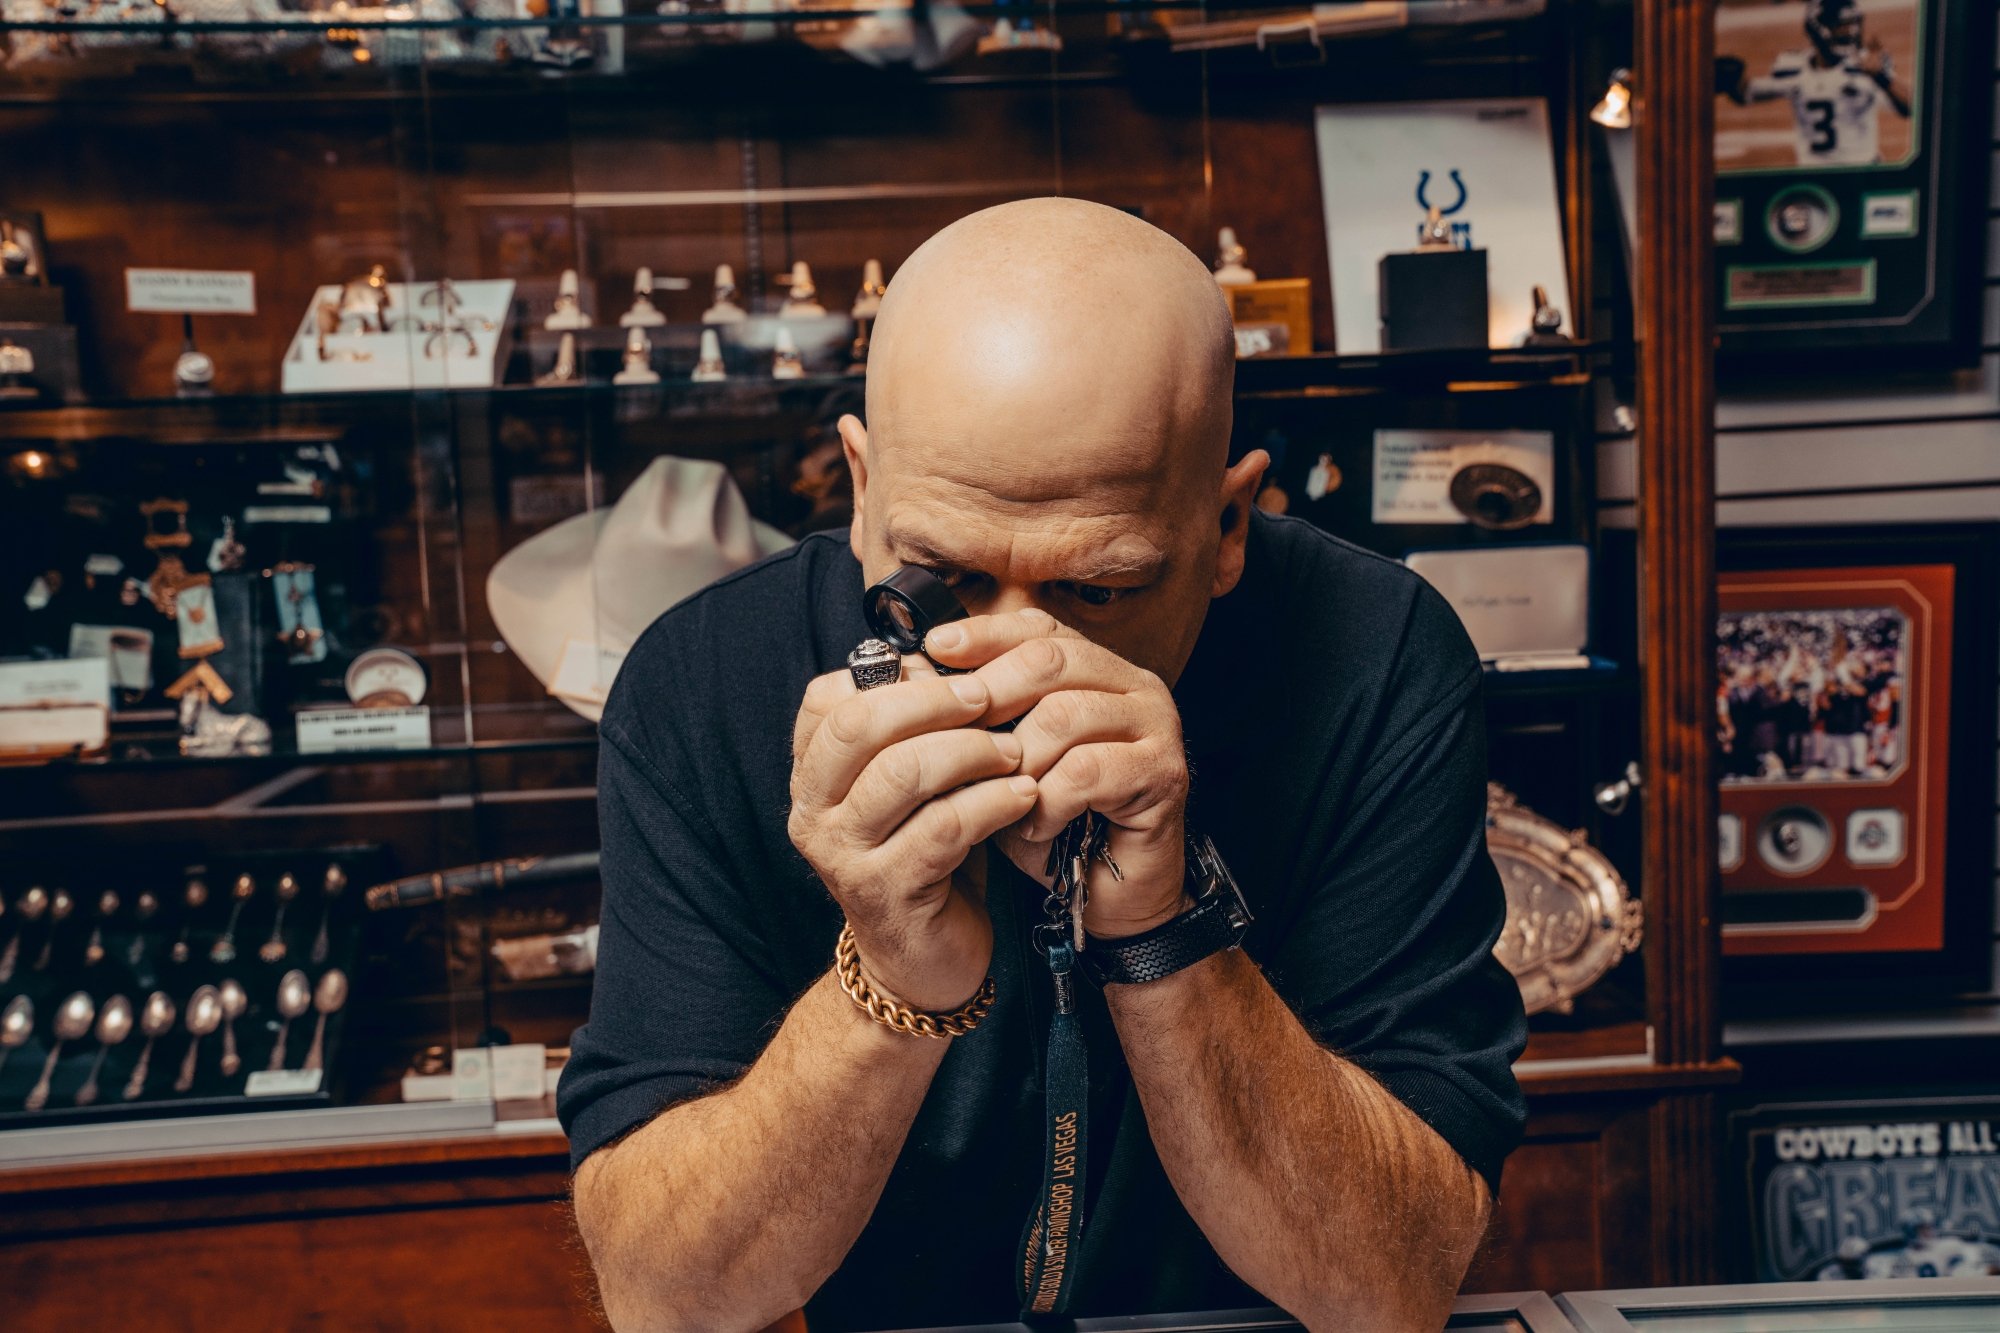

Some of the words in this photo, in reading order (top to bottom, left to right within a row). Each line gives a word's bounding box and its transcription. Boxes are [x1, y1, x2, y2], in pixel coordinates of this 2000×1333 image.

[1806, 101, 1835, 152] 3
[1055, 1112, 1077, 1156] VEGAS
[1776, 1124, 1941, 1158] COWBOYS
[1053, 1156, 1075, 1179] LAS
[1050, 1183, 1073, 1237] PAWNSHOP
[1766, 1158, 2000, 1280] GREA
[1045, 1239, 1067, 1266] SILVER
[1040, 1272, 1063, 1289] GOLD
